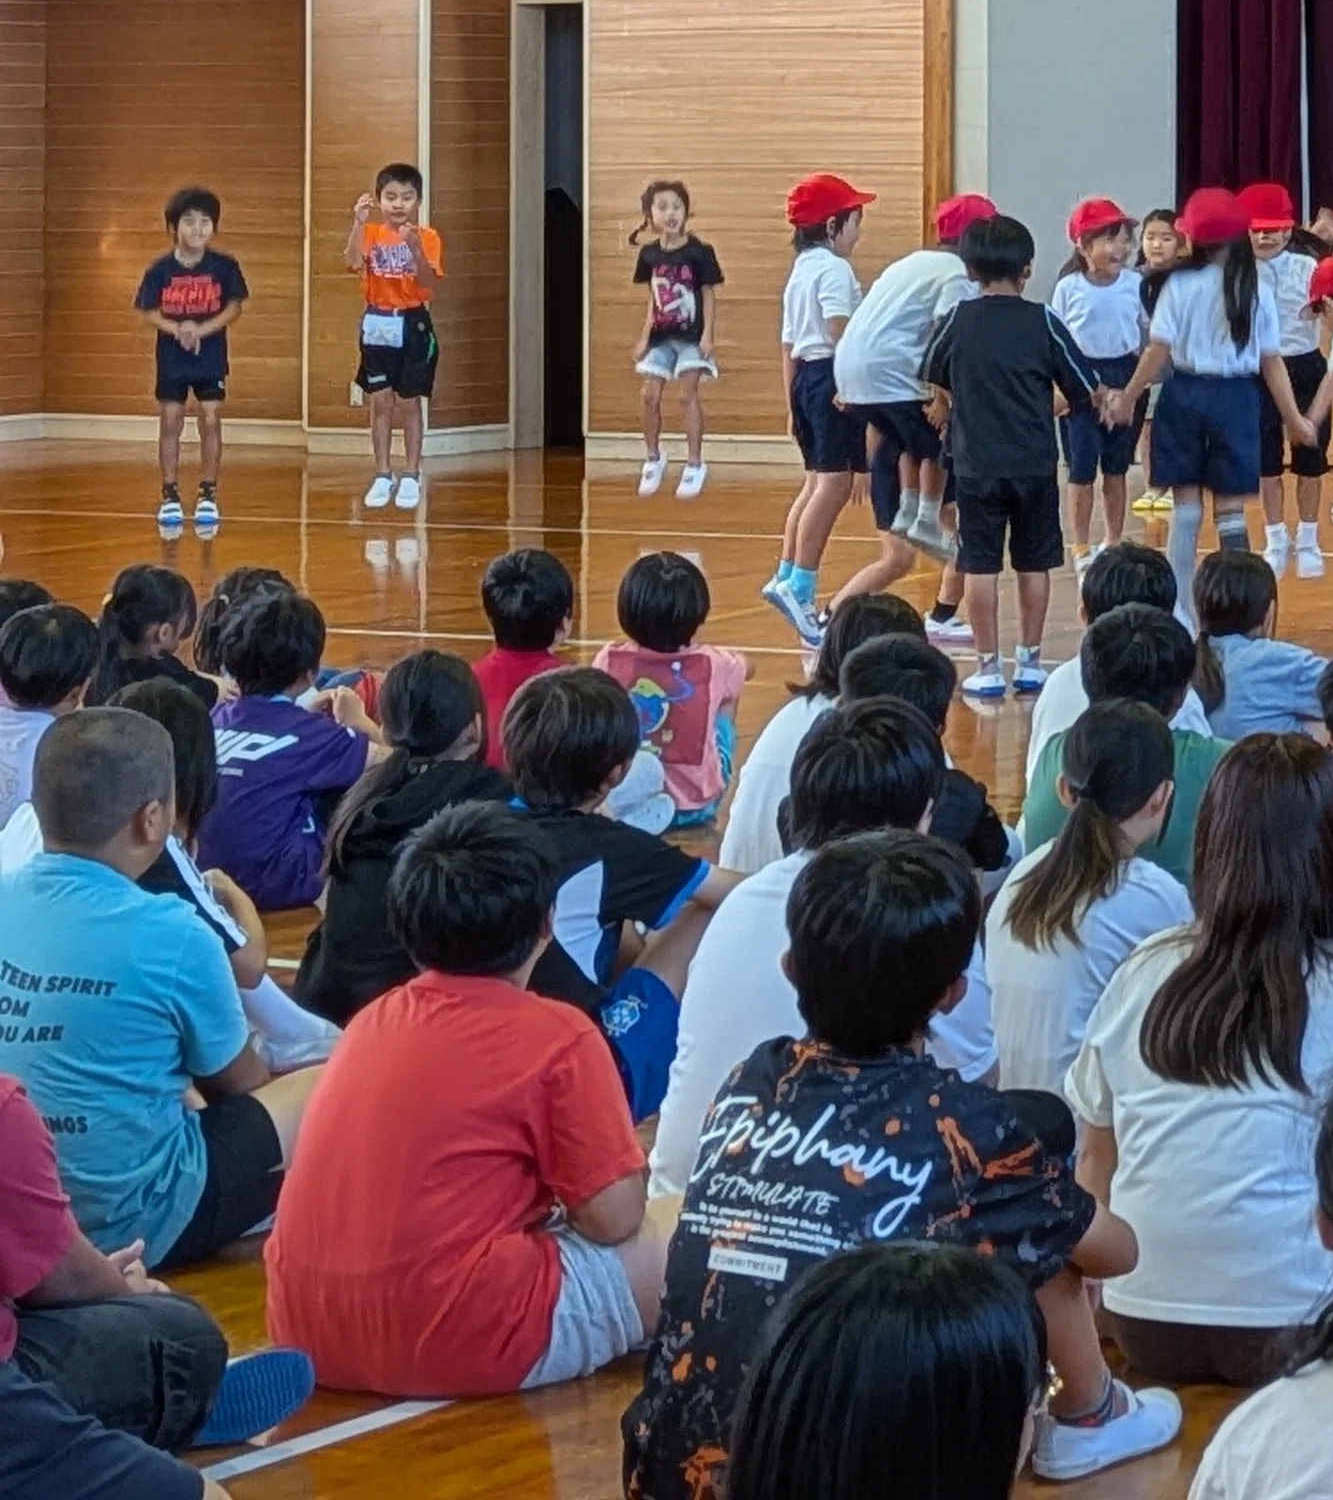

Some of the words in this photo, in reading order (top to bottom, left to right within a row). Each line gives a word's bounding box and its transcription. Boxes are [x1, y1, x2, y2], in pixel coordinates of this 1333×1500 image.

[0, 960, 43, 994] TEEN
[45, 975, 117, 998] SPIRIT
[21, 1025, 64, 1043] ARE
[689, 1094, 933, 1238] Epiphany
[706, 1172, 840, 1215] STIMULATE
